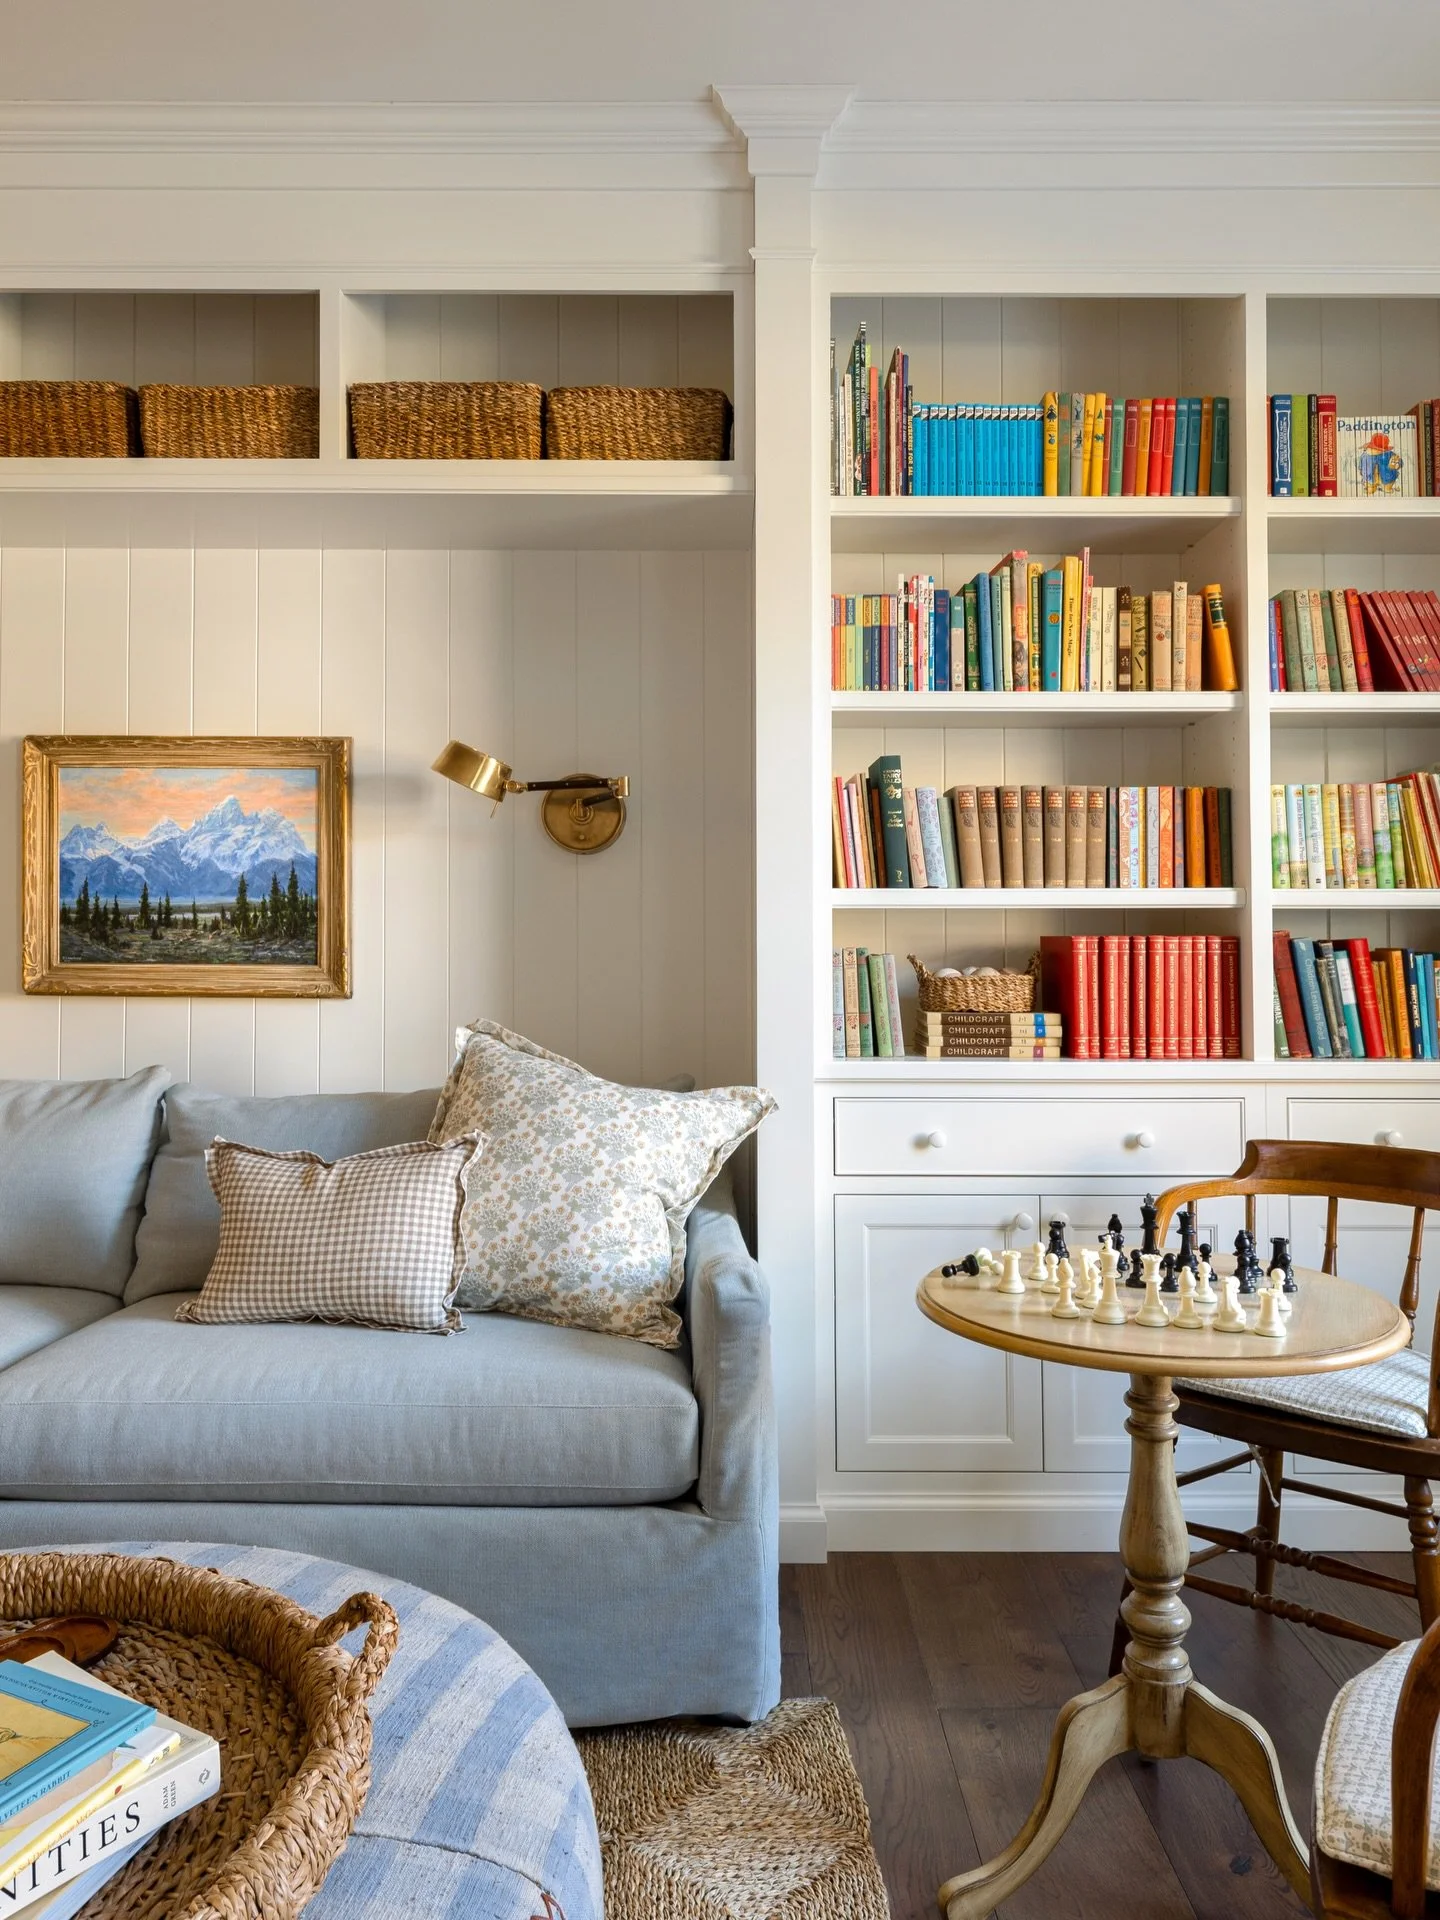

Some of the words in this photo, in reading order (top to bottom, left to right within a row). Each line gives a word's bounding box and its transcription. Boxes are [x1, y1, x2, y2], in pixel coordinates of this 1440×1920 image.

[1338, 420, 1416, 434] Paddington
[1394, 634, 1440, 645] TINTI
[1310, 799, 1318, 811] The
[1310, 813, 1319, 830] Long
[1311, 832, 1321, 853] Winter
[1305, 959, 1315, 990] Children
[1311, 991, 1319, 1012] Learn
[1317, 1021, 1326, 1040] Read
[0, 1791, 38, 1823] VETEEN
[40, 1770, 71, 1794] RABBIT
[0, 1801, 140, 1900] VITIES
